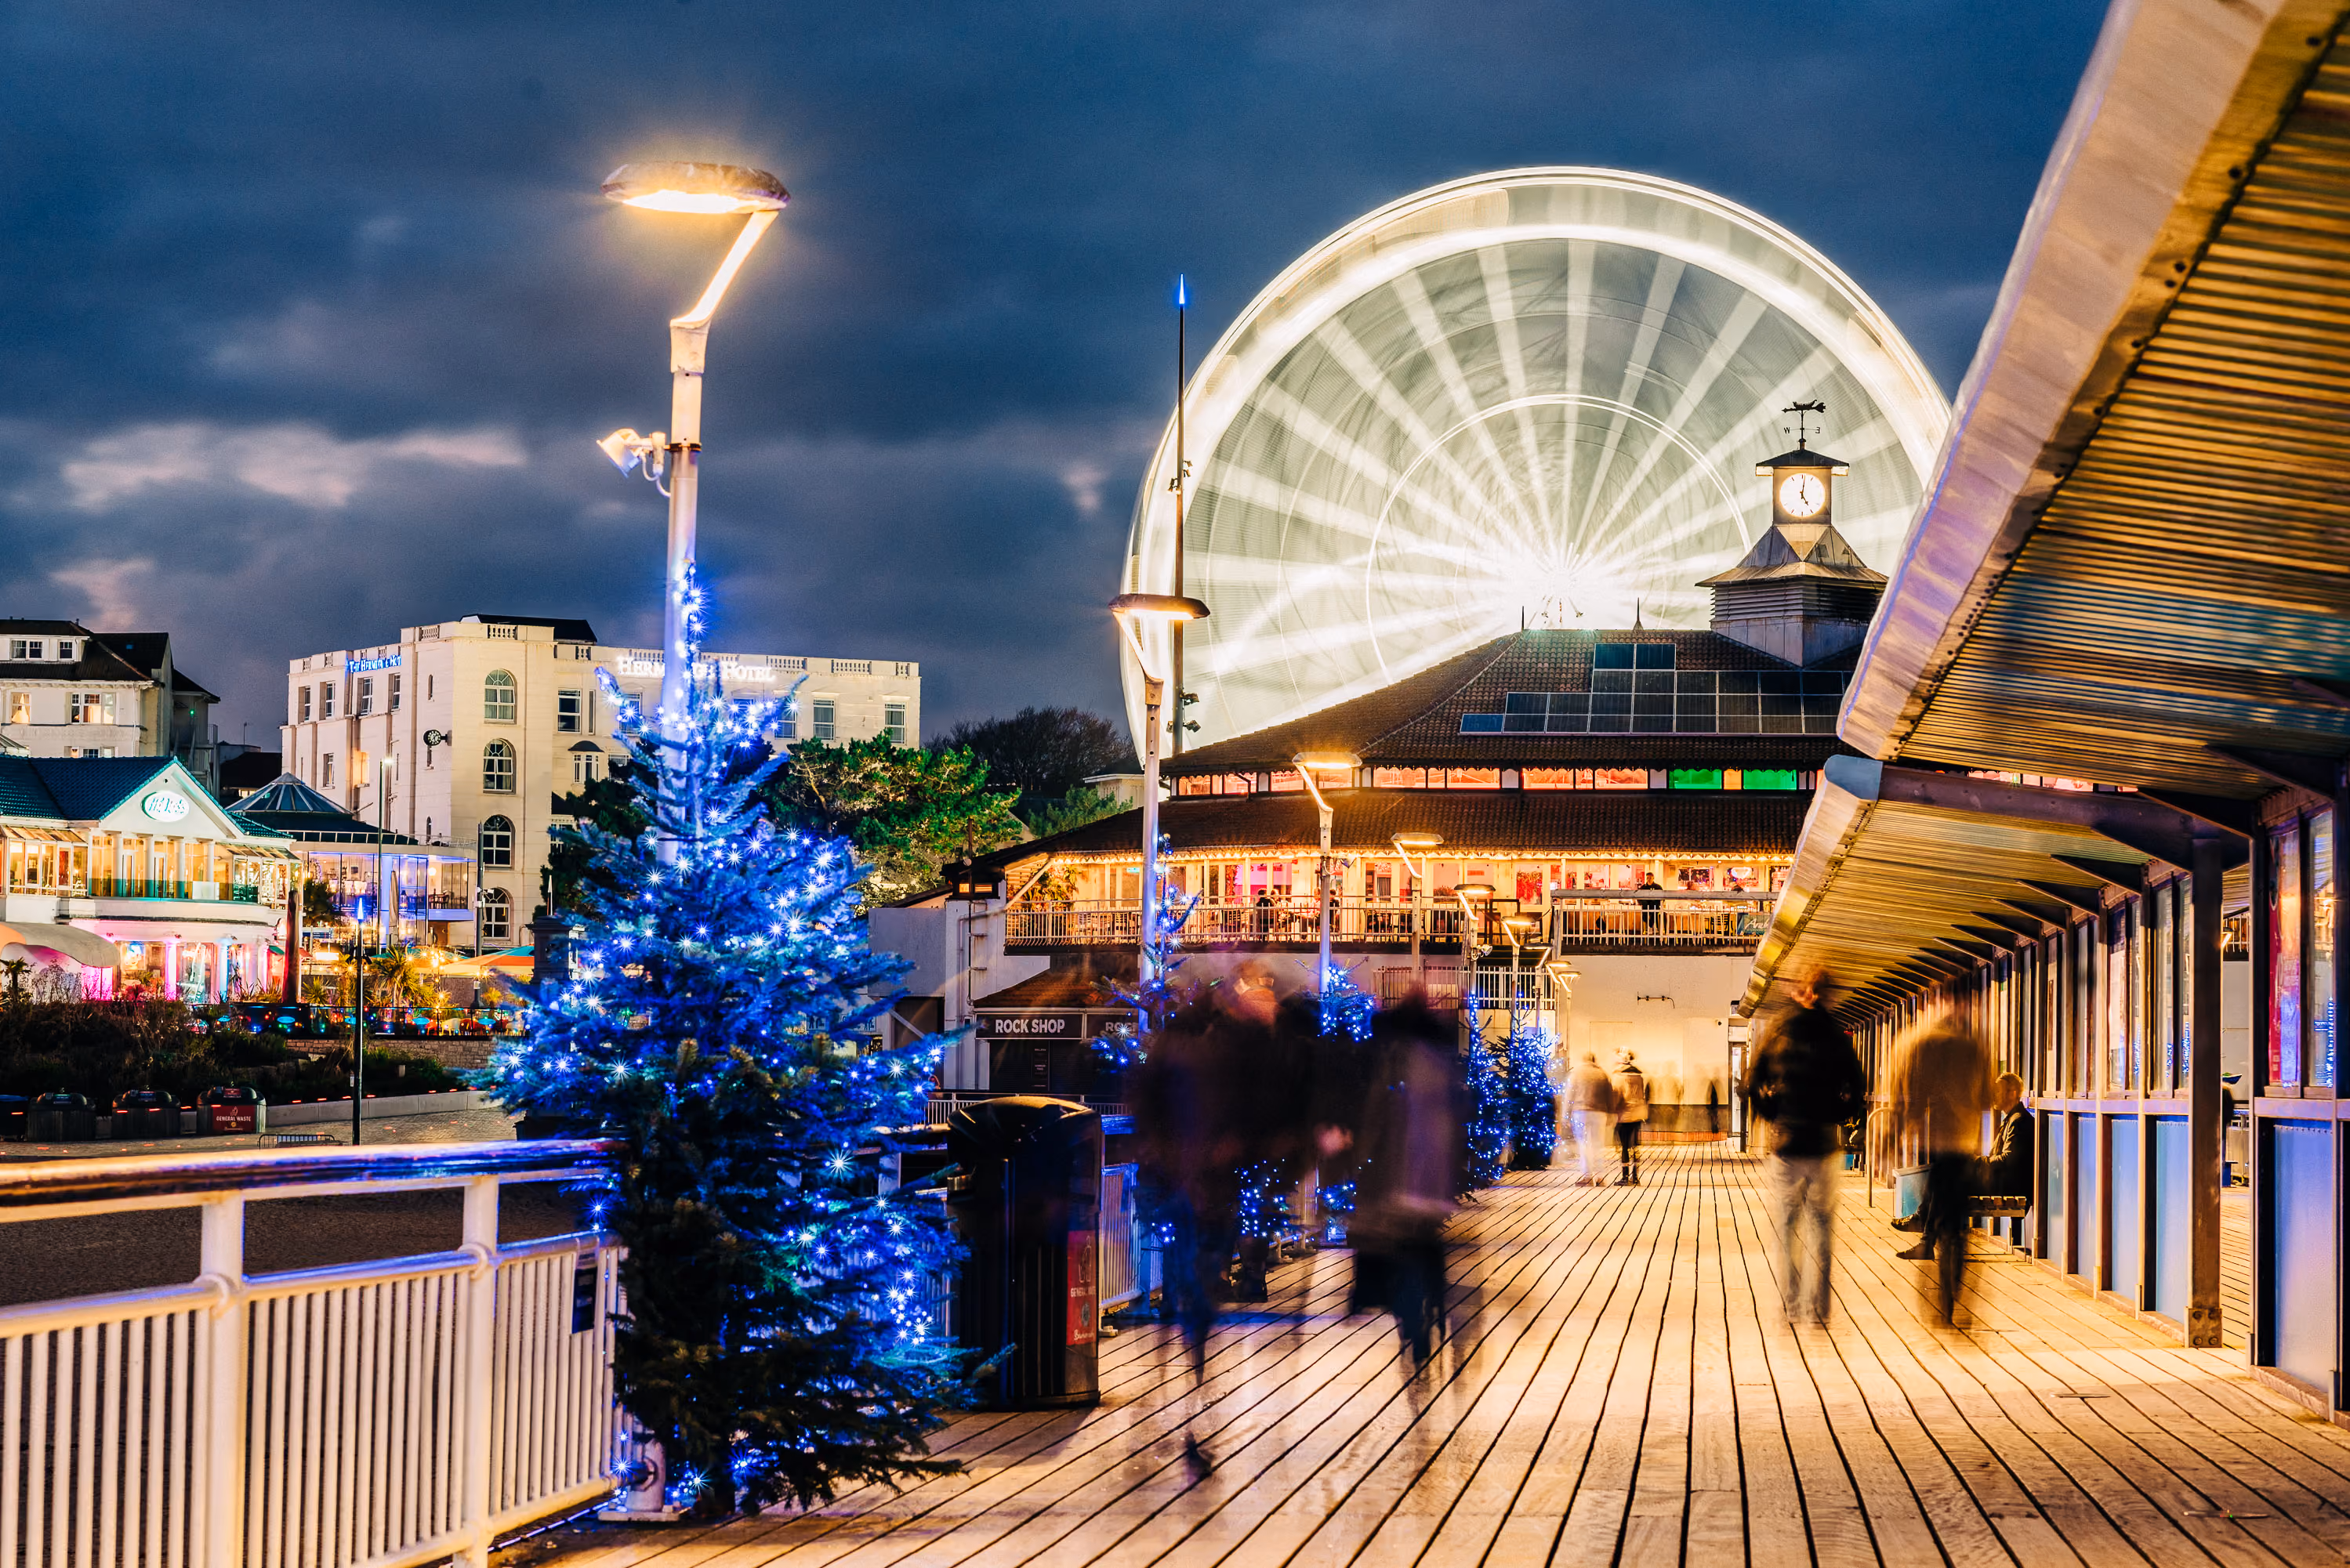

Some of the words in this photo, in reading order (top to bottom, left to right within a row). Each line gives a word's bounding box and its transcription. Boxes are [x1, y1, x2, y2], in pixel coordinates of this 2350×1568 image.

[361, 657, 389, 672] HERME
[615, 656, 715, 679] HERMGE
[720, 661, 776, 683] HOTEL
[1744, 918, 1770, 929] Arub
[995, 1019, 1029, 1034] ROCK
[1031, 1019, 1065, 1034] SHOP
